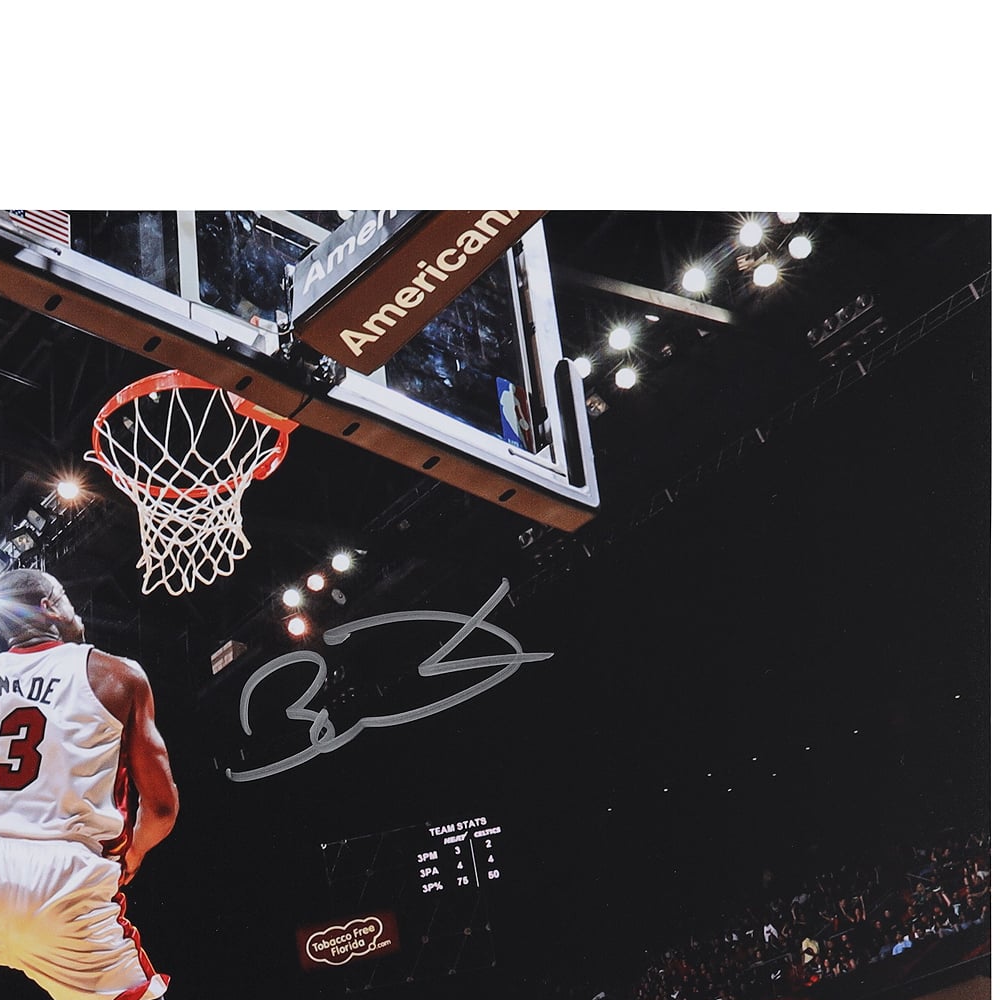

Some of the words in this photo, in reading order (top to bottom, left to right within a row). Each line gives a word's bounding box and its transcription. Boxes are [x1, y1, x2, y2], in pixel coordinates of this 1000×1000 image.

[429, 824, 455, 837] TEAM
[457, 817, 487, 831] STATS
[417, 851, 438, 863] 3PM
[454, 846, 461, 855] 3
[485, 839, 492, 848] 2
[420, 866, 440, 878] 3PA
[457, 861, 464, 869] 4
[487, 854, 494, 863] 4
[422, 881, 444, 893] 3P%
[312, 933, 353, 952] Tobacco
[353, 924, 376, 939] Free
[330, 939, 366, 957] Florida
[376, 939, 392, 949] .com
